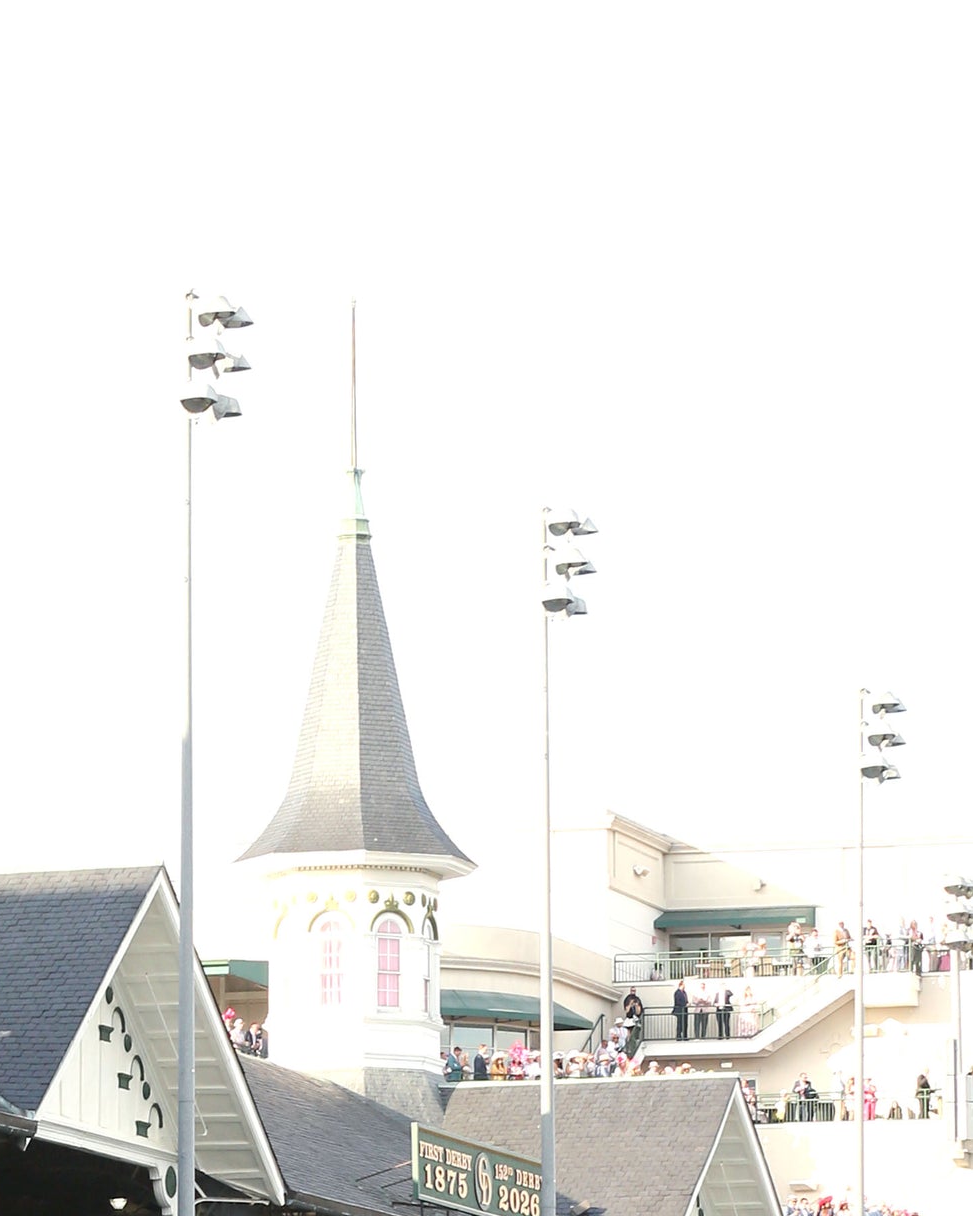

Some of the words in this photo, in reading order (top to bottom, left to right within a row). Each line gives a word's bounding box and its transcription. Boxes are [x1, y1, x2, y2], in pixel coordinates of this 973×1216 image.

[419, 1141, 444, 1162] FIRST
[445, 1148, 472, 1171] DERBY
[425, 1163, 468, 1199] 1875
[515, 1169, 542, 1191] DERB
